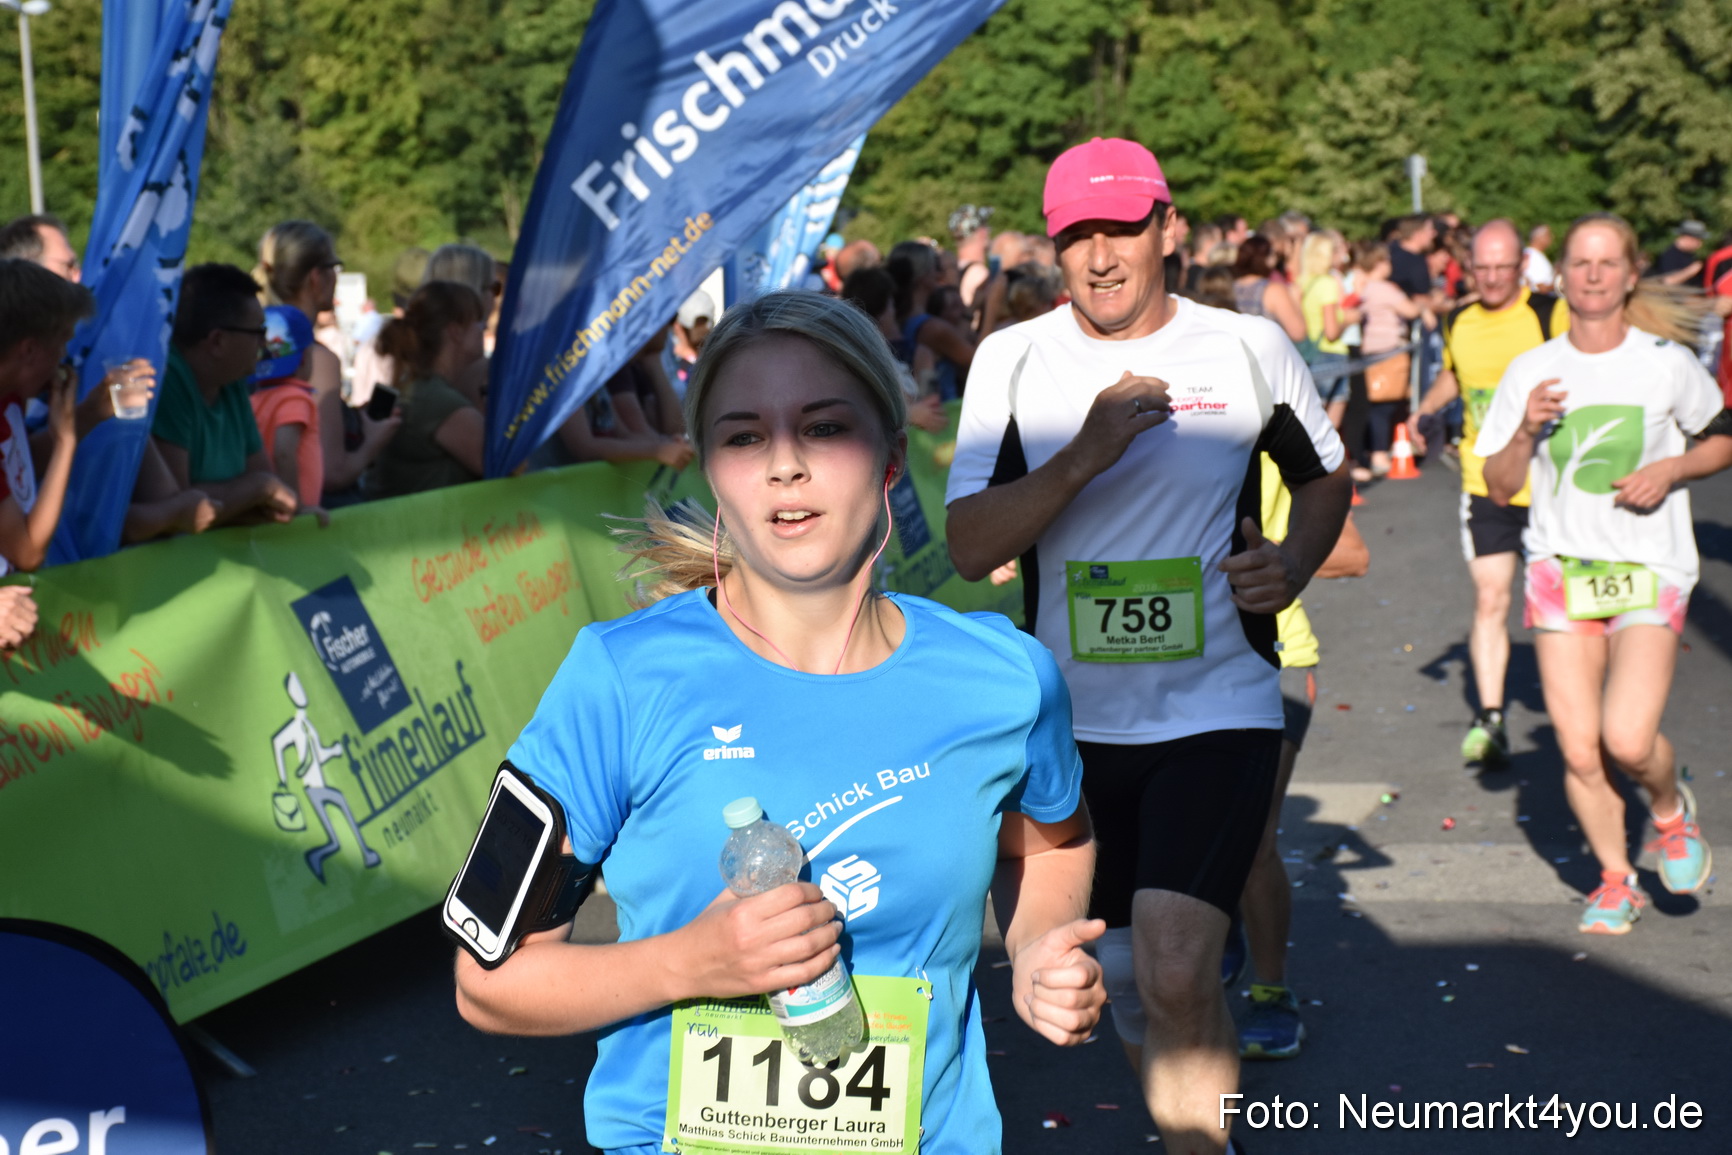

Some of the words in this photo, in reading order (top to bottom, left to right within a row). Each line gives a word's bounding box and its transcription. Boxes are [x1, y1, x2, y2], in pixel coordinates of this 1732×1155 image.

[806, 0, 899, 79] Druck
[504, 208, 713, 440] www.frischmann-net.de
[1169, 401, 1229, 414] partner
[1186, 386, 1214, 394] TEAM
[1586, 573, 1634, 598] 161
[1094, 596, 1172, 634] 758
[322, 623, 370, 663] Fischer
[1106, 635, 1137, 646] Metka
[1139, 634, 1166, 645] Bertl
[54, 647, 175, 743] länger!
[341, 659, 487, 815] firmenlauf
[703, 745, 756, 762] erima
[381, 787, 441, 849] neumarkt
[785, 781, 874, 842] Schick
[876, 761, 931, 791] Bau
[704, 1012, 743, 1020] neumarkt
[705, 999, 776, 1015] firmenla
[703, 1037, 891, 1112] 1184
[0, 1105, 126, 1155] er
[678, 1122, 725, 1139] Matthias
[728, 1128, 767, 1143] Schick
[769, 1134, 867, 1149] Bauunternehmen
[870, 1137, 905, 1149] GmbH
[700, 1106, 829, 1135] Guttenberger
[833, 1116, 887, 1134] Laura
